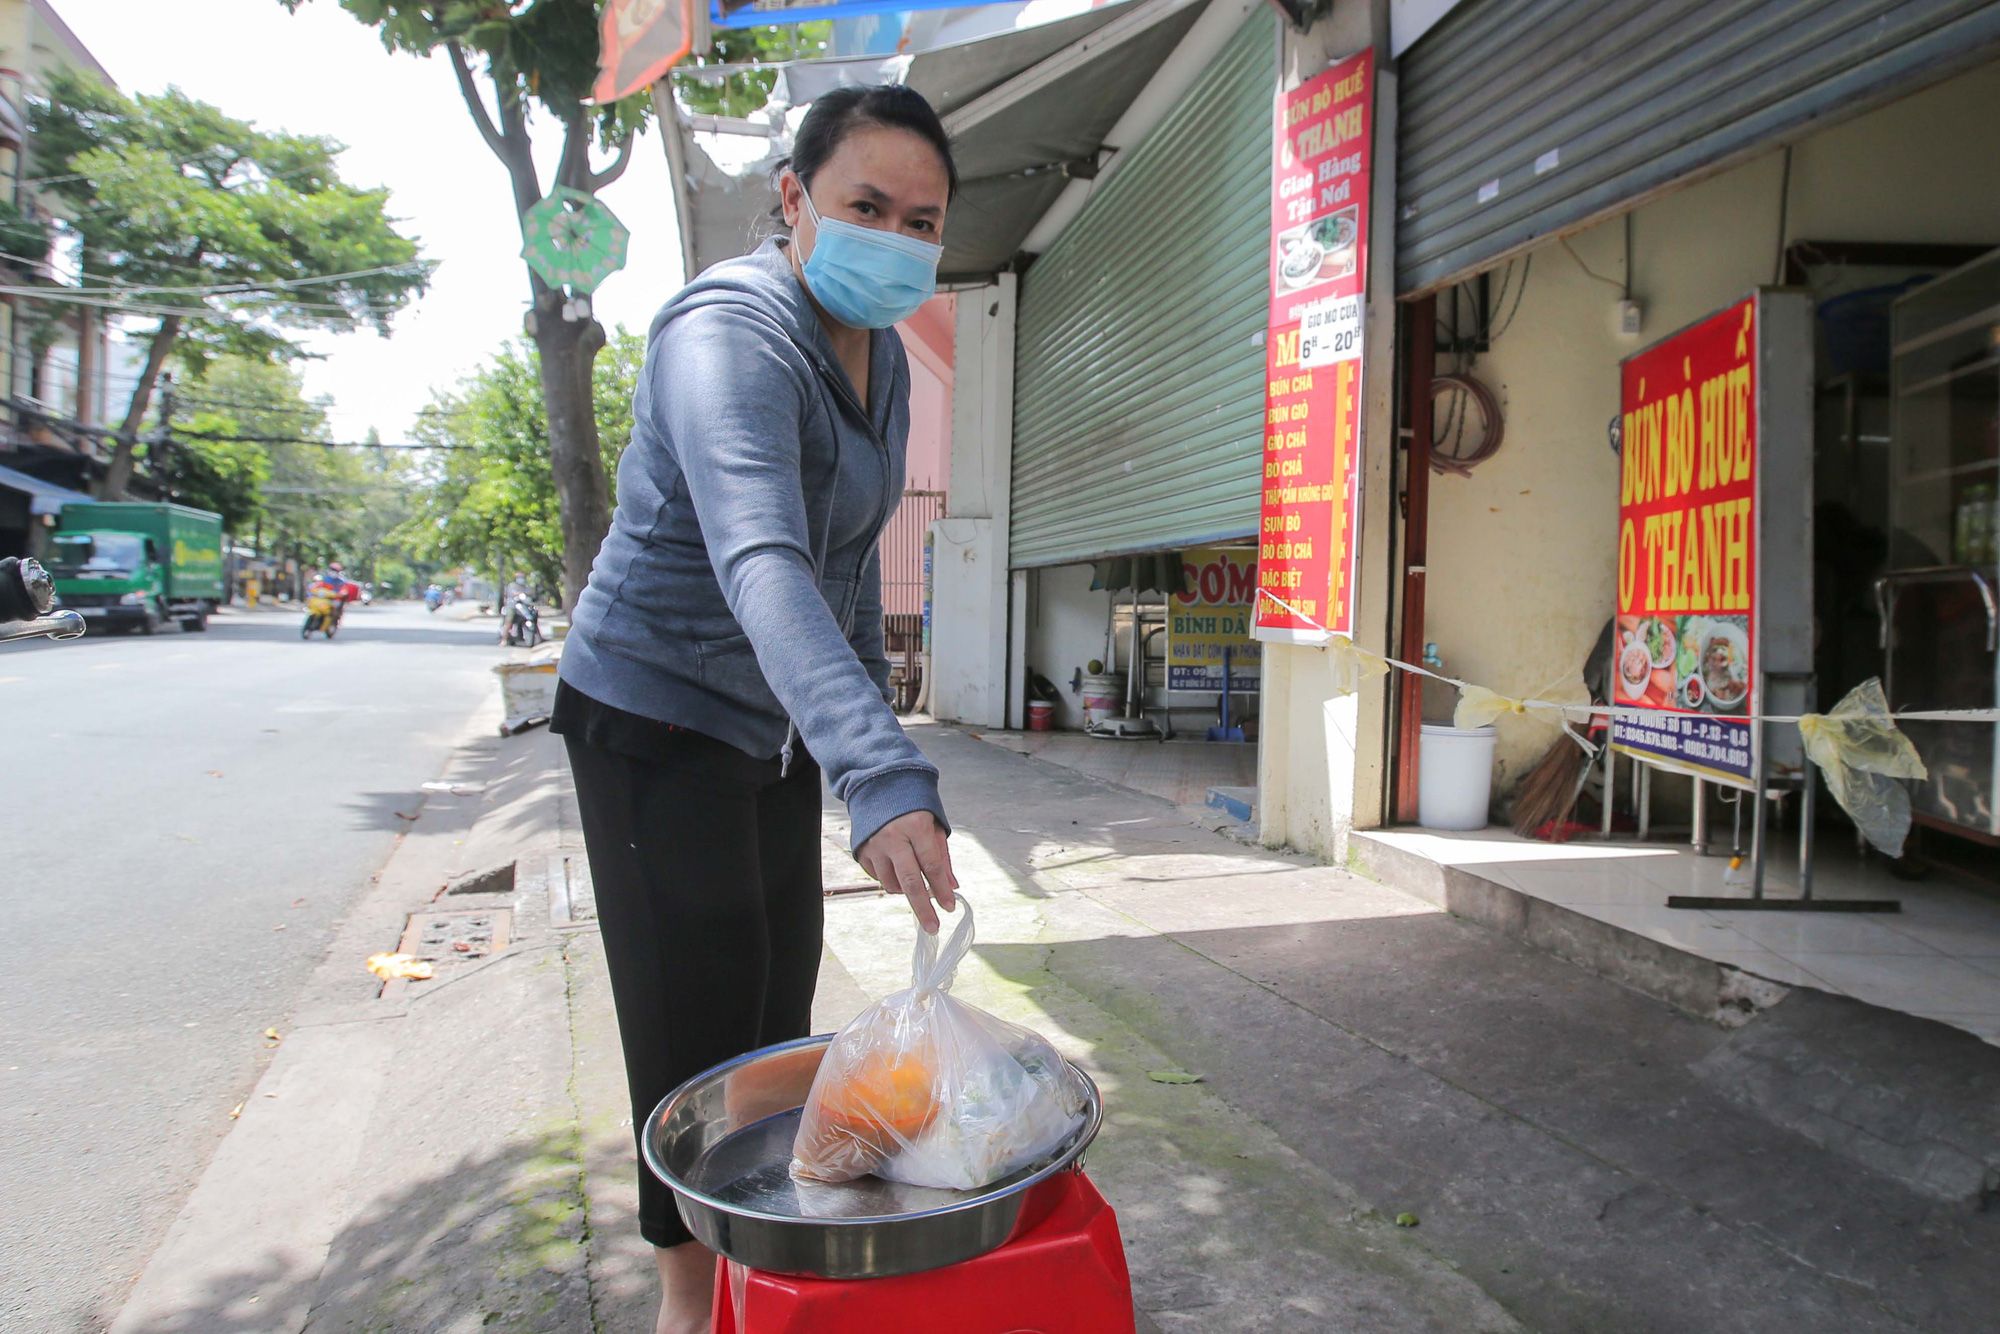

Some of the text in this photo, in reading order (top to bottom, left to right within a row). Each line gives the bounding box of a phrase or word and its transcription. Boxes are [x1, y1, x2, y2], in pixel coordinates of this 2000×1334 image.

[1283, 60, 1365, 129] BÚN BÒ HUẾ
[1281, 103, 1363, 170] O THANH
[1279, 151, 1361, 199] Giao Hàng
[1287, 178, 1350, 222] Tận Nơi
[1269, 375, 1290, 397] BÚN
[1292, 368, 1313, 393] CHẢ
[1268, 403, 1289, 424] BÚN
[1291, 398, 1308, 420] GIÒ
[1621, 303, 1752, 507] BÚN BÒ HUẾ
[1267, 430, 1284, 451] GIÒ
[1286, 424, 1307, 449] CHẢ
[1266, 457, 1280, 478] BÒ
[1282, 453, 1302, 477] CHẢ
[1265, 485, 1281, 507] THẬP
[1297, 482, 1320, 503] KHÔNG
[1321, 480, 1334, 501] GIÒ
[1264, 516, 1283, 535] SỤN
[1286, 510, 1301, 531] BÒ
[1262, 540, 1275, 559] BÒ
[1277, 539, 1292, 559] GIÒ
[1294, 536, 1312, 559] CHẢ
[1619, 497, 1751, 613] O THANH
[1262, 568, 1279, 591] ĐẶC
[1281, 567, 1302, 591] BIỆT
[1174, 612, 1251, 634] BÌNH DÂ
[1681, 720, 1692, 735] 10
